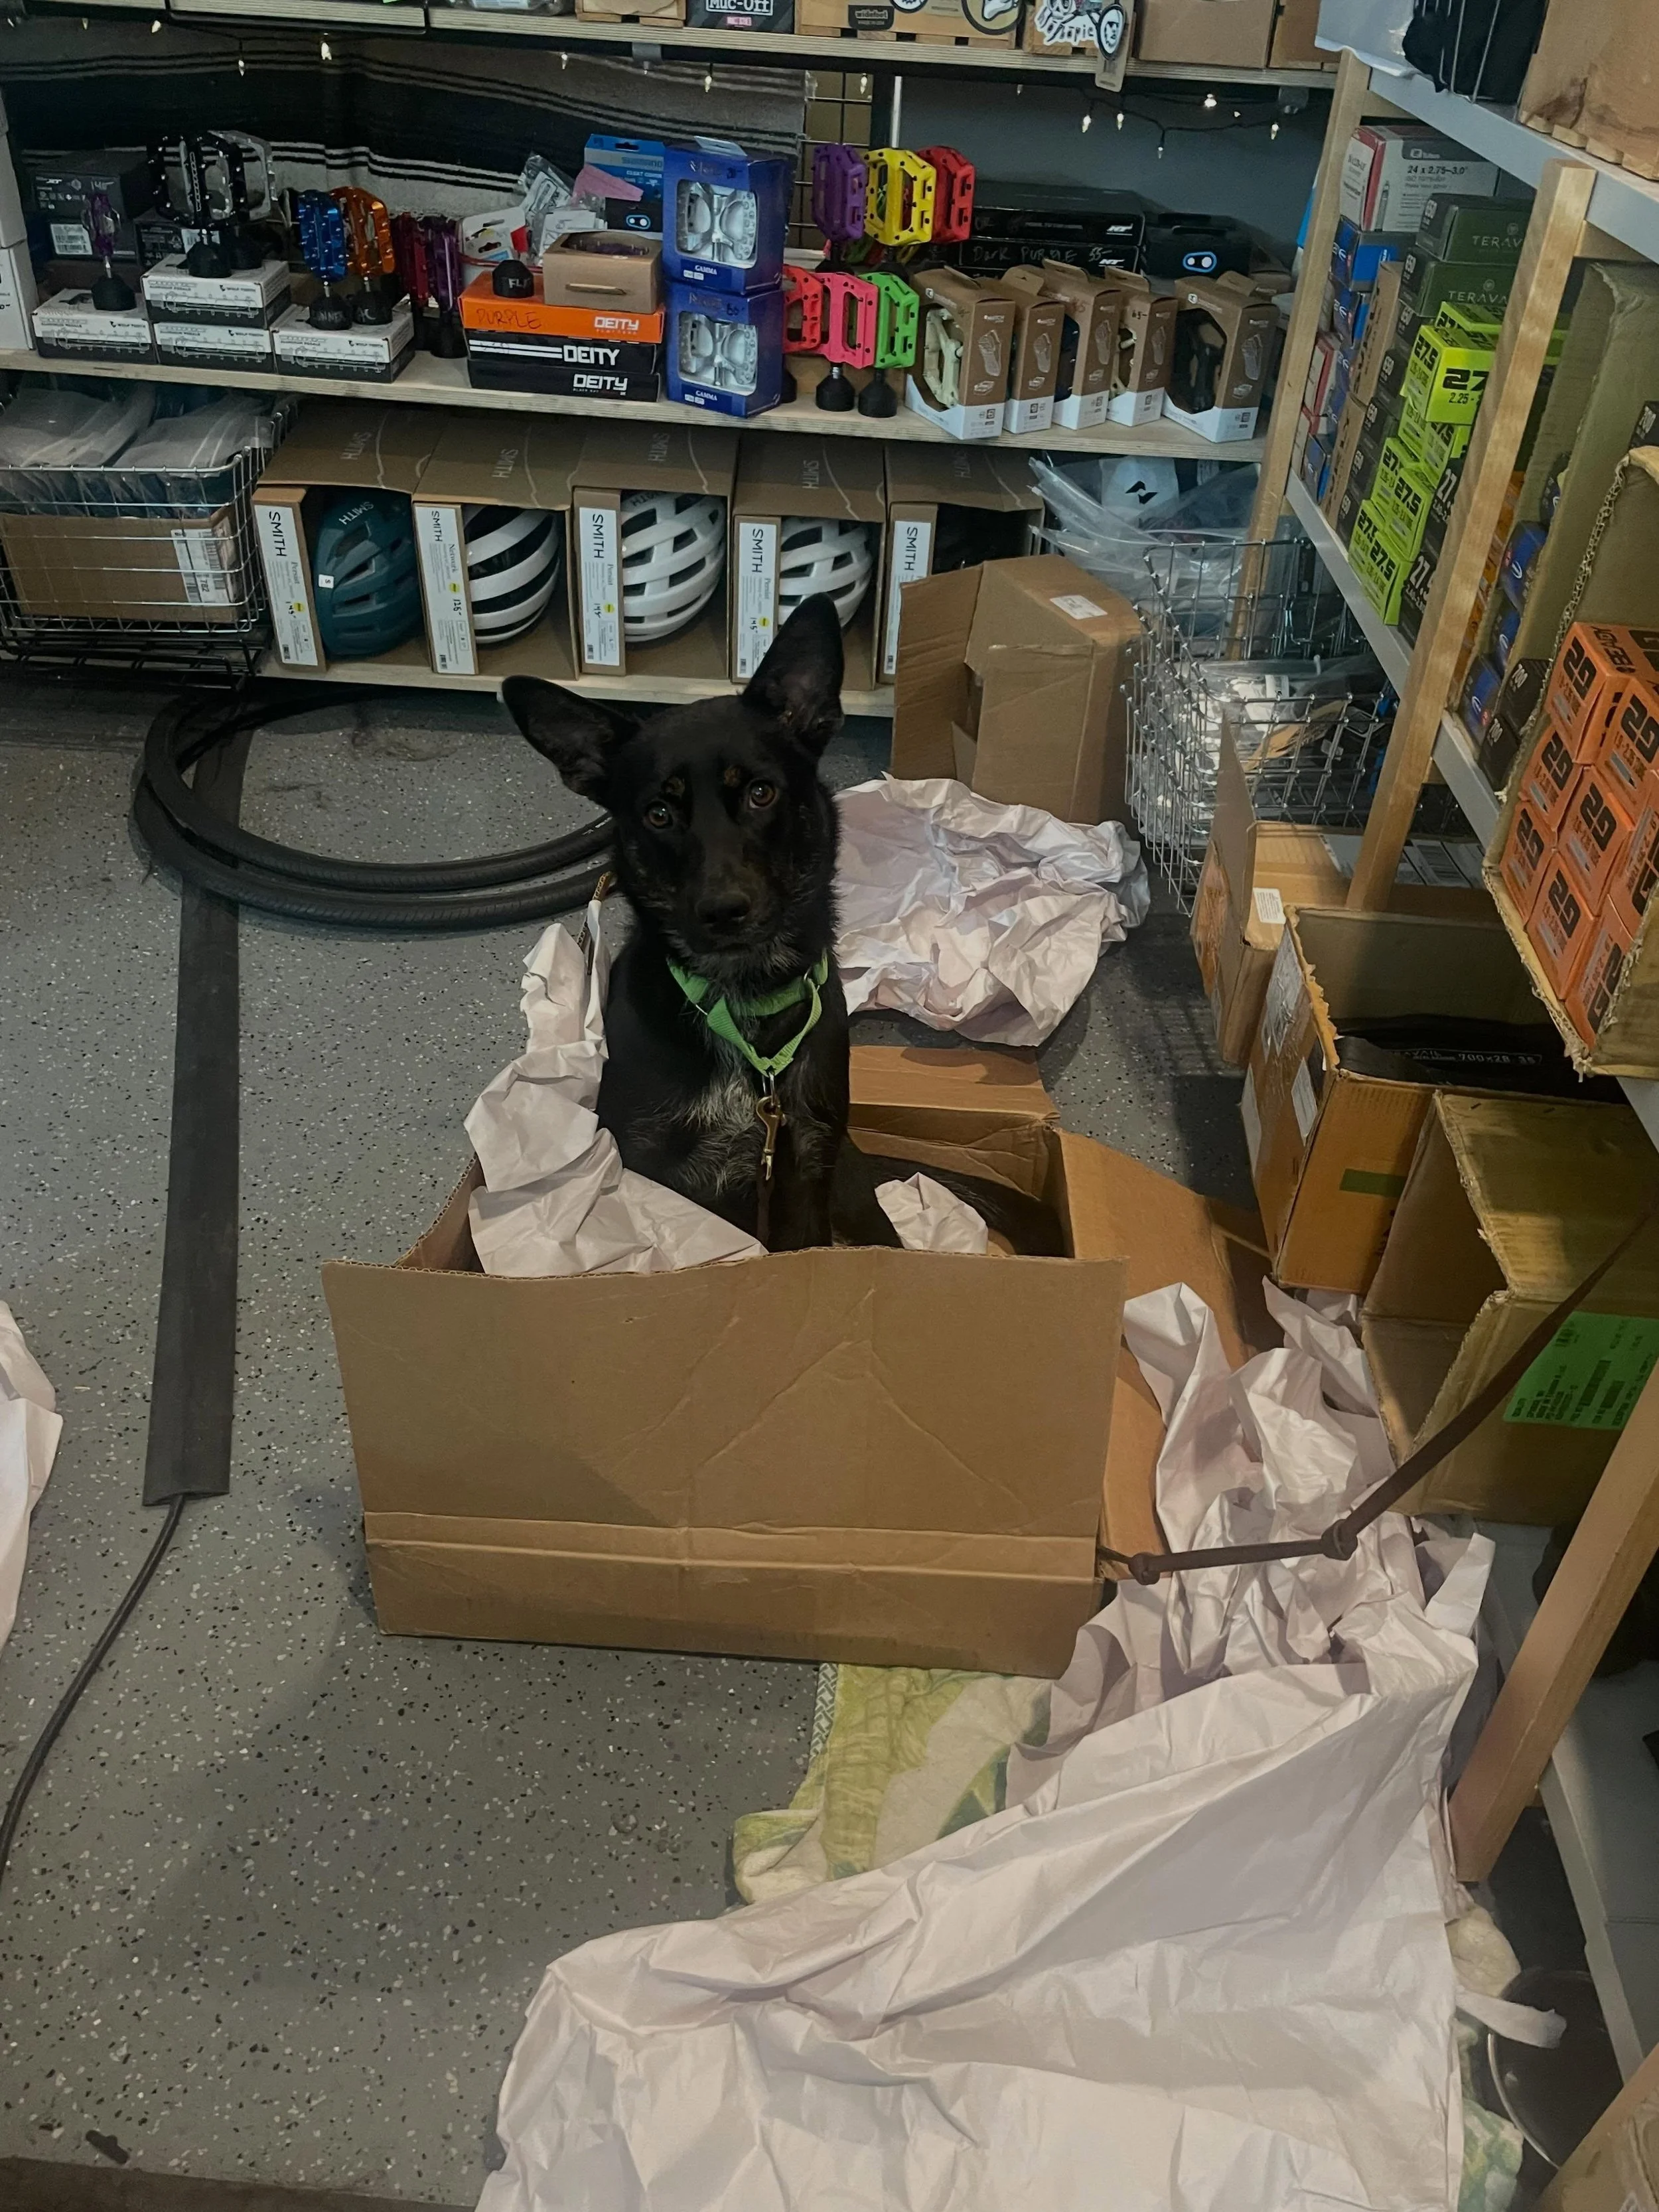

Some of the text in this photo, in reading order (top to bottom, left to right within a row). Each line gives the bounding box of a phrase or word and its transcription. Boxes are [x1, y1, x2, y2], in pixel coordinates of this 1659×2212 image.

[1407, 165, 1418, 174] 24
[476, 308, 542, 329] PURPLE
[595, 317, 639, 331] DEITY
[563, 345, 620, 366] DEITY
[573, 374, 628, 391] DEITY
[492, 449, 519, 479] SMITH
[802, 460, 819, 489] SMITH
[338, 502, 374, 525] SMITH
[431, 511, 443, 542] SMITH
[269, 511, 287, 556] SMITH
[592, 514, 605, 559] SMITH
[904, 527, 918, 571] SMITH
[752, 528, 764, 573] SMITH
[1563, 636, 1597, 701] 29
[1541, 729, 1573, 791] 29
[1580, 782, 1617, 852] 29
[1548, 869, 1581, 938] 29
